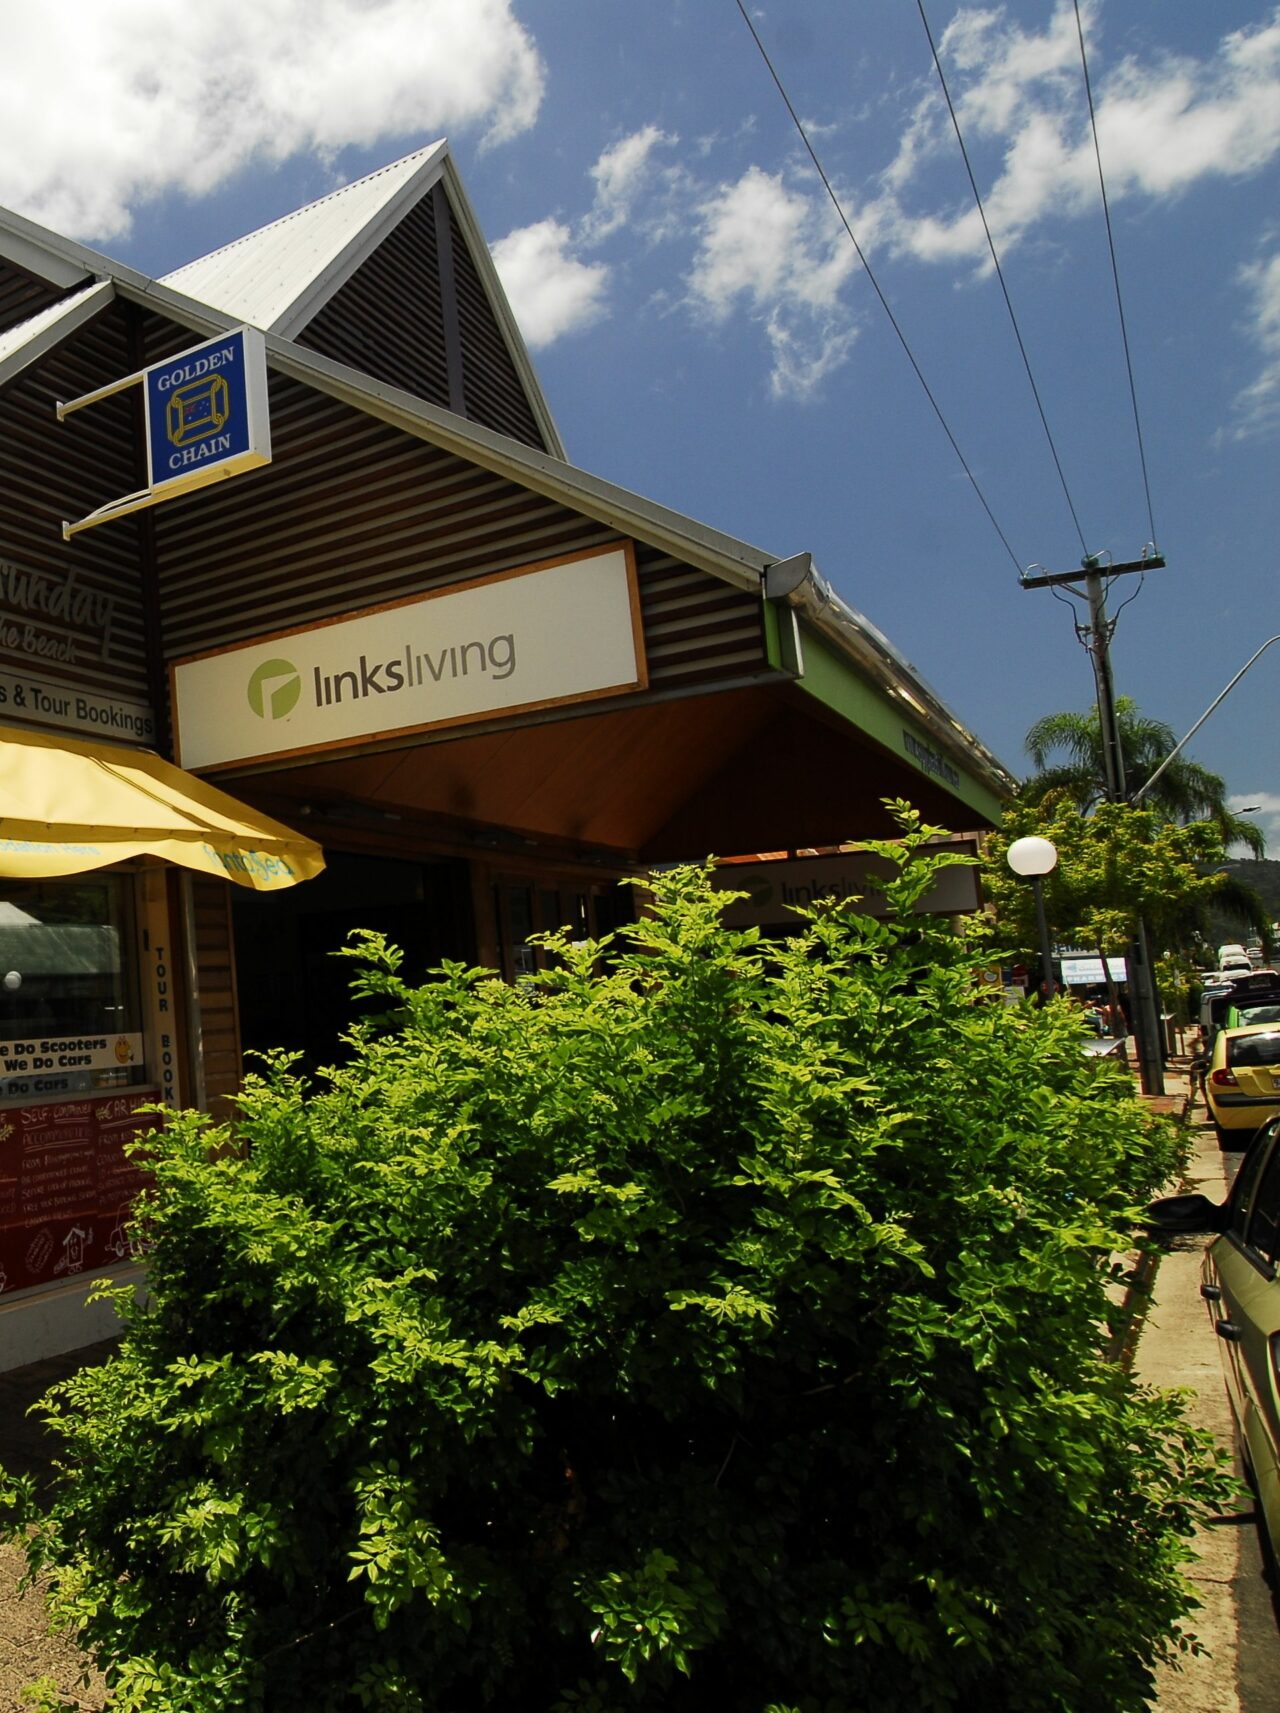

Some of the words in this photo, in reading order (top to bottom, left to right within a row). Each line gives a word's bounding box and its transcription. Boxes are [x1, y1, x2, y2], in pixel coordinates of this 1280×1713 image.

[157, 346, 235, 392] GOLDEN
[169, 433, 232, 470] CHAIN
[22, 625, 77, 665] Beach
[313, 633, 517, 708] linksliving
[13, 686, 27, 706] &
[30, 687, 71, 718] Tour
[76, 701, 153, 737] Bookings
[156, 947, 169, 1012] TOUR
[4, 1060, 28, 1072] We
[33, 1057, 53, 1069] Do
[58, 1054, 92, 1067] Cars
[14, 1042, 35, 1055] Do
[40, 1038, 107, 1054] Scooters
[8, 1082, 29, 1095] Do
[34, 1078, 68, 1092] Cars
[161, 1034, 175, 1105] BOOK
